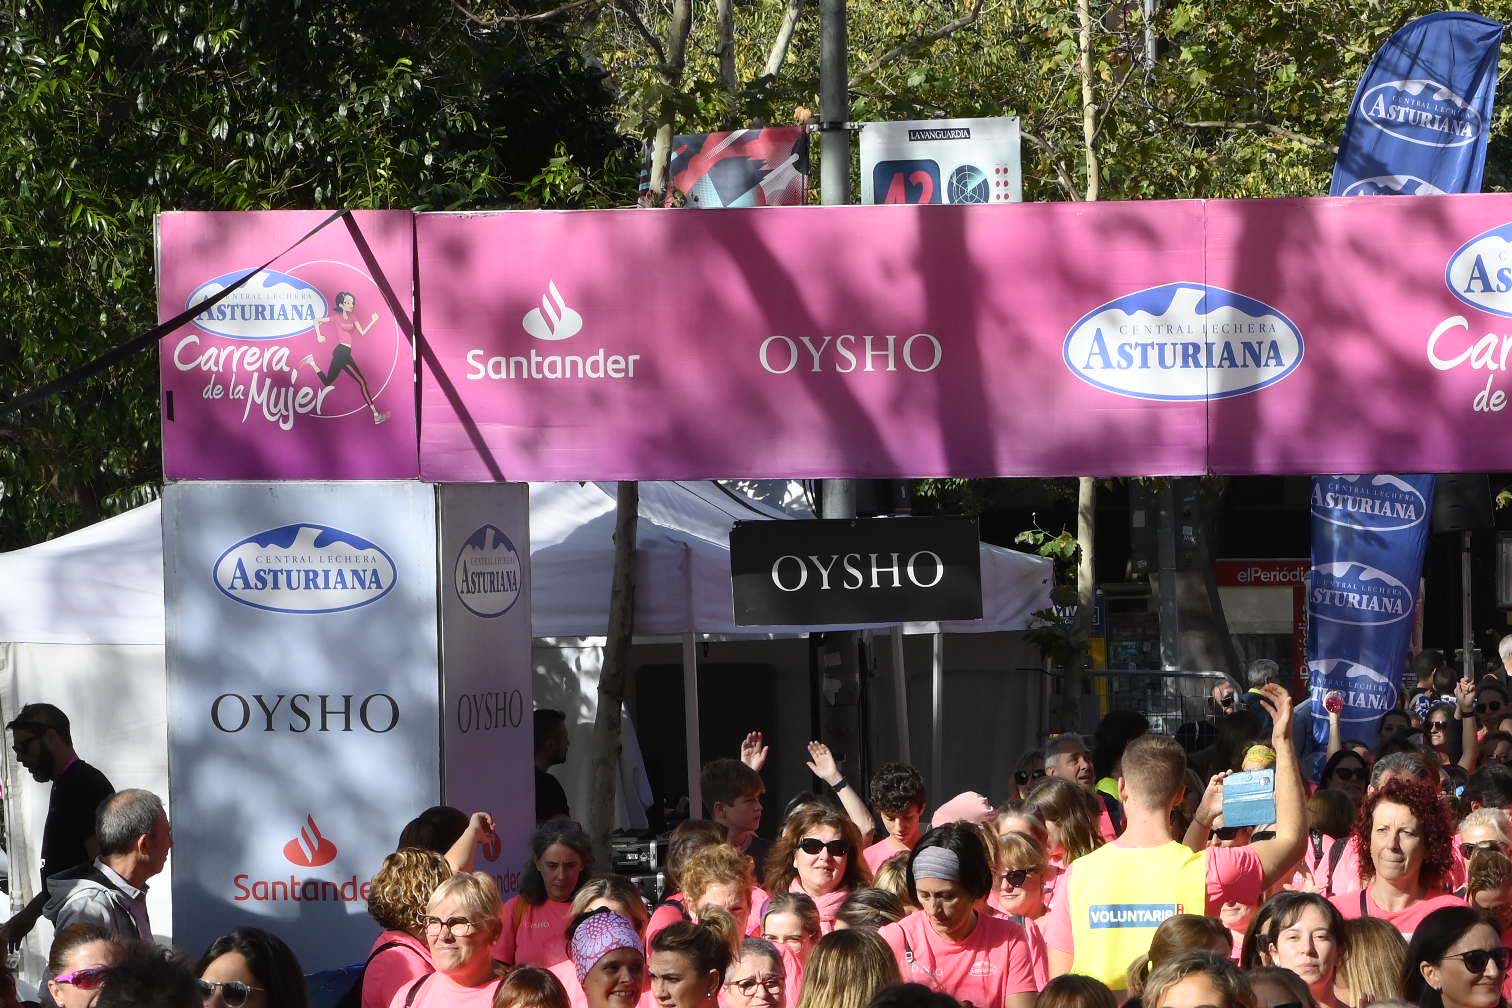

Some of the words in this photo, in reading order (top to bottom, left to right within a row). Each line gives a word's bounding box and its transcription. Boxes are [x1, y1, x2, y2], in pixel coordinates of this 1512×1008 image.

[1368, 93, 1473, 137] ASTURIANA
[197, 295, 316, 321] ASTURIANA
[1119, 323, 1194, 334] CENTRAL
[1202, 322, 1277, 334] LECHERA
[173, 334, 291, 374] Carrera
[467, 348, 640, 380] Santander
[759, 334, 942, 373] OYSHO
[1082, 327, 1285, 370] ASTURIANA
[202, 373, 224, 400] de
[229, 373, 244, 400] la
[242, 369, 334, 431] Mujer
[1473, 375, 1507, 413] de
[1312, 482, 1417, 520] ASTURIANA
[228, 557, 384, 591] ASTURIANA
[256, 554, 313, 564] CENTRAL
[319, 554, 378, 564] LECHERA
[460, 559, 518, 594] ASTURIANA
[770, 549, 946, 592] OYSHO
[1237, 567, 1305, 583] elPeriódi
[1311, 587, 1404, 615] STURIANA
[211, 692, 400, 733] OYSHO
[457, 689, 523, 734] OYSHO
[234, 874, 373, 902] Santande
